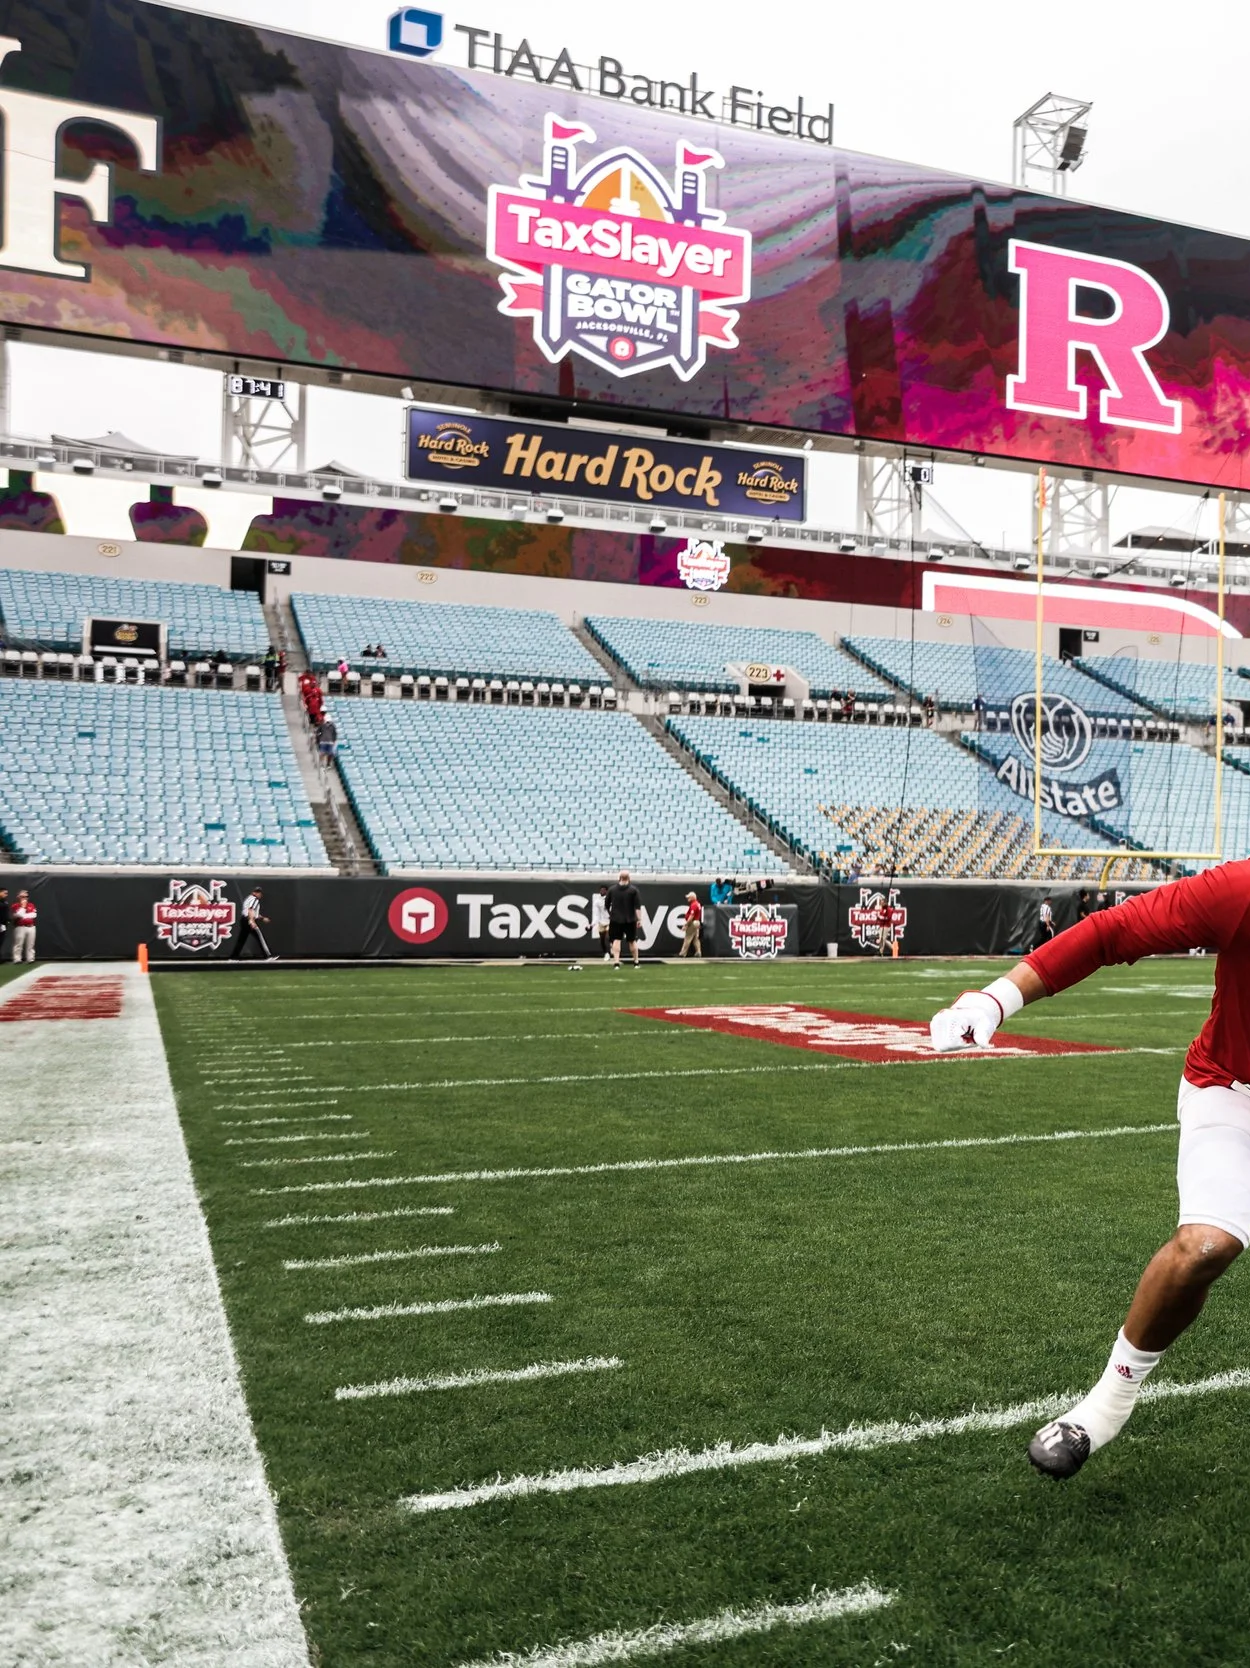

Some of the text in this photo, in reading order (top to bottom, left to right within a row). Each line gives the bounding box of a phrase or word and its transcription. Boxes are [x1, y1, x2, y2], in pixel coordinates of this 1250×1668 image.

[455, 24, 834, 144] TIAA Bank Field
[507, 204, 733, 277] TaxSlayer
[566, 274, 677, 309] GATOR
[567, 293, 678, 334] BOWL
[1006, 238, 1181, 433] R
[418, 434, 490, 457] Hard Rock
[503, 433, 722, 507] Hard Rock
[737, 472, 799, 494] Hard Rock
[749, 667, 768, 679] 223
[997, 754, 1119, 816] Allstate
[160, 906, 230, 921] TaxSlayer
[852, 910, 903, 921] TaxSer
[178, 928, 214, 936] BOWL
[733, 922, 784, 935] TaxSlayer
